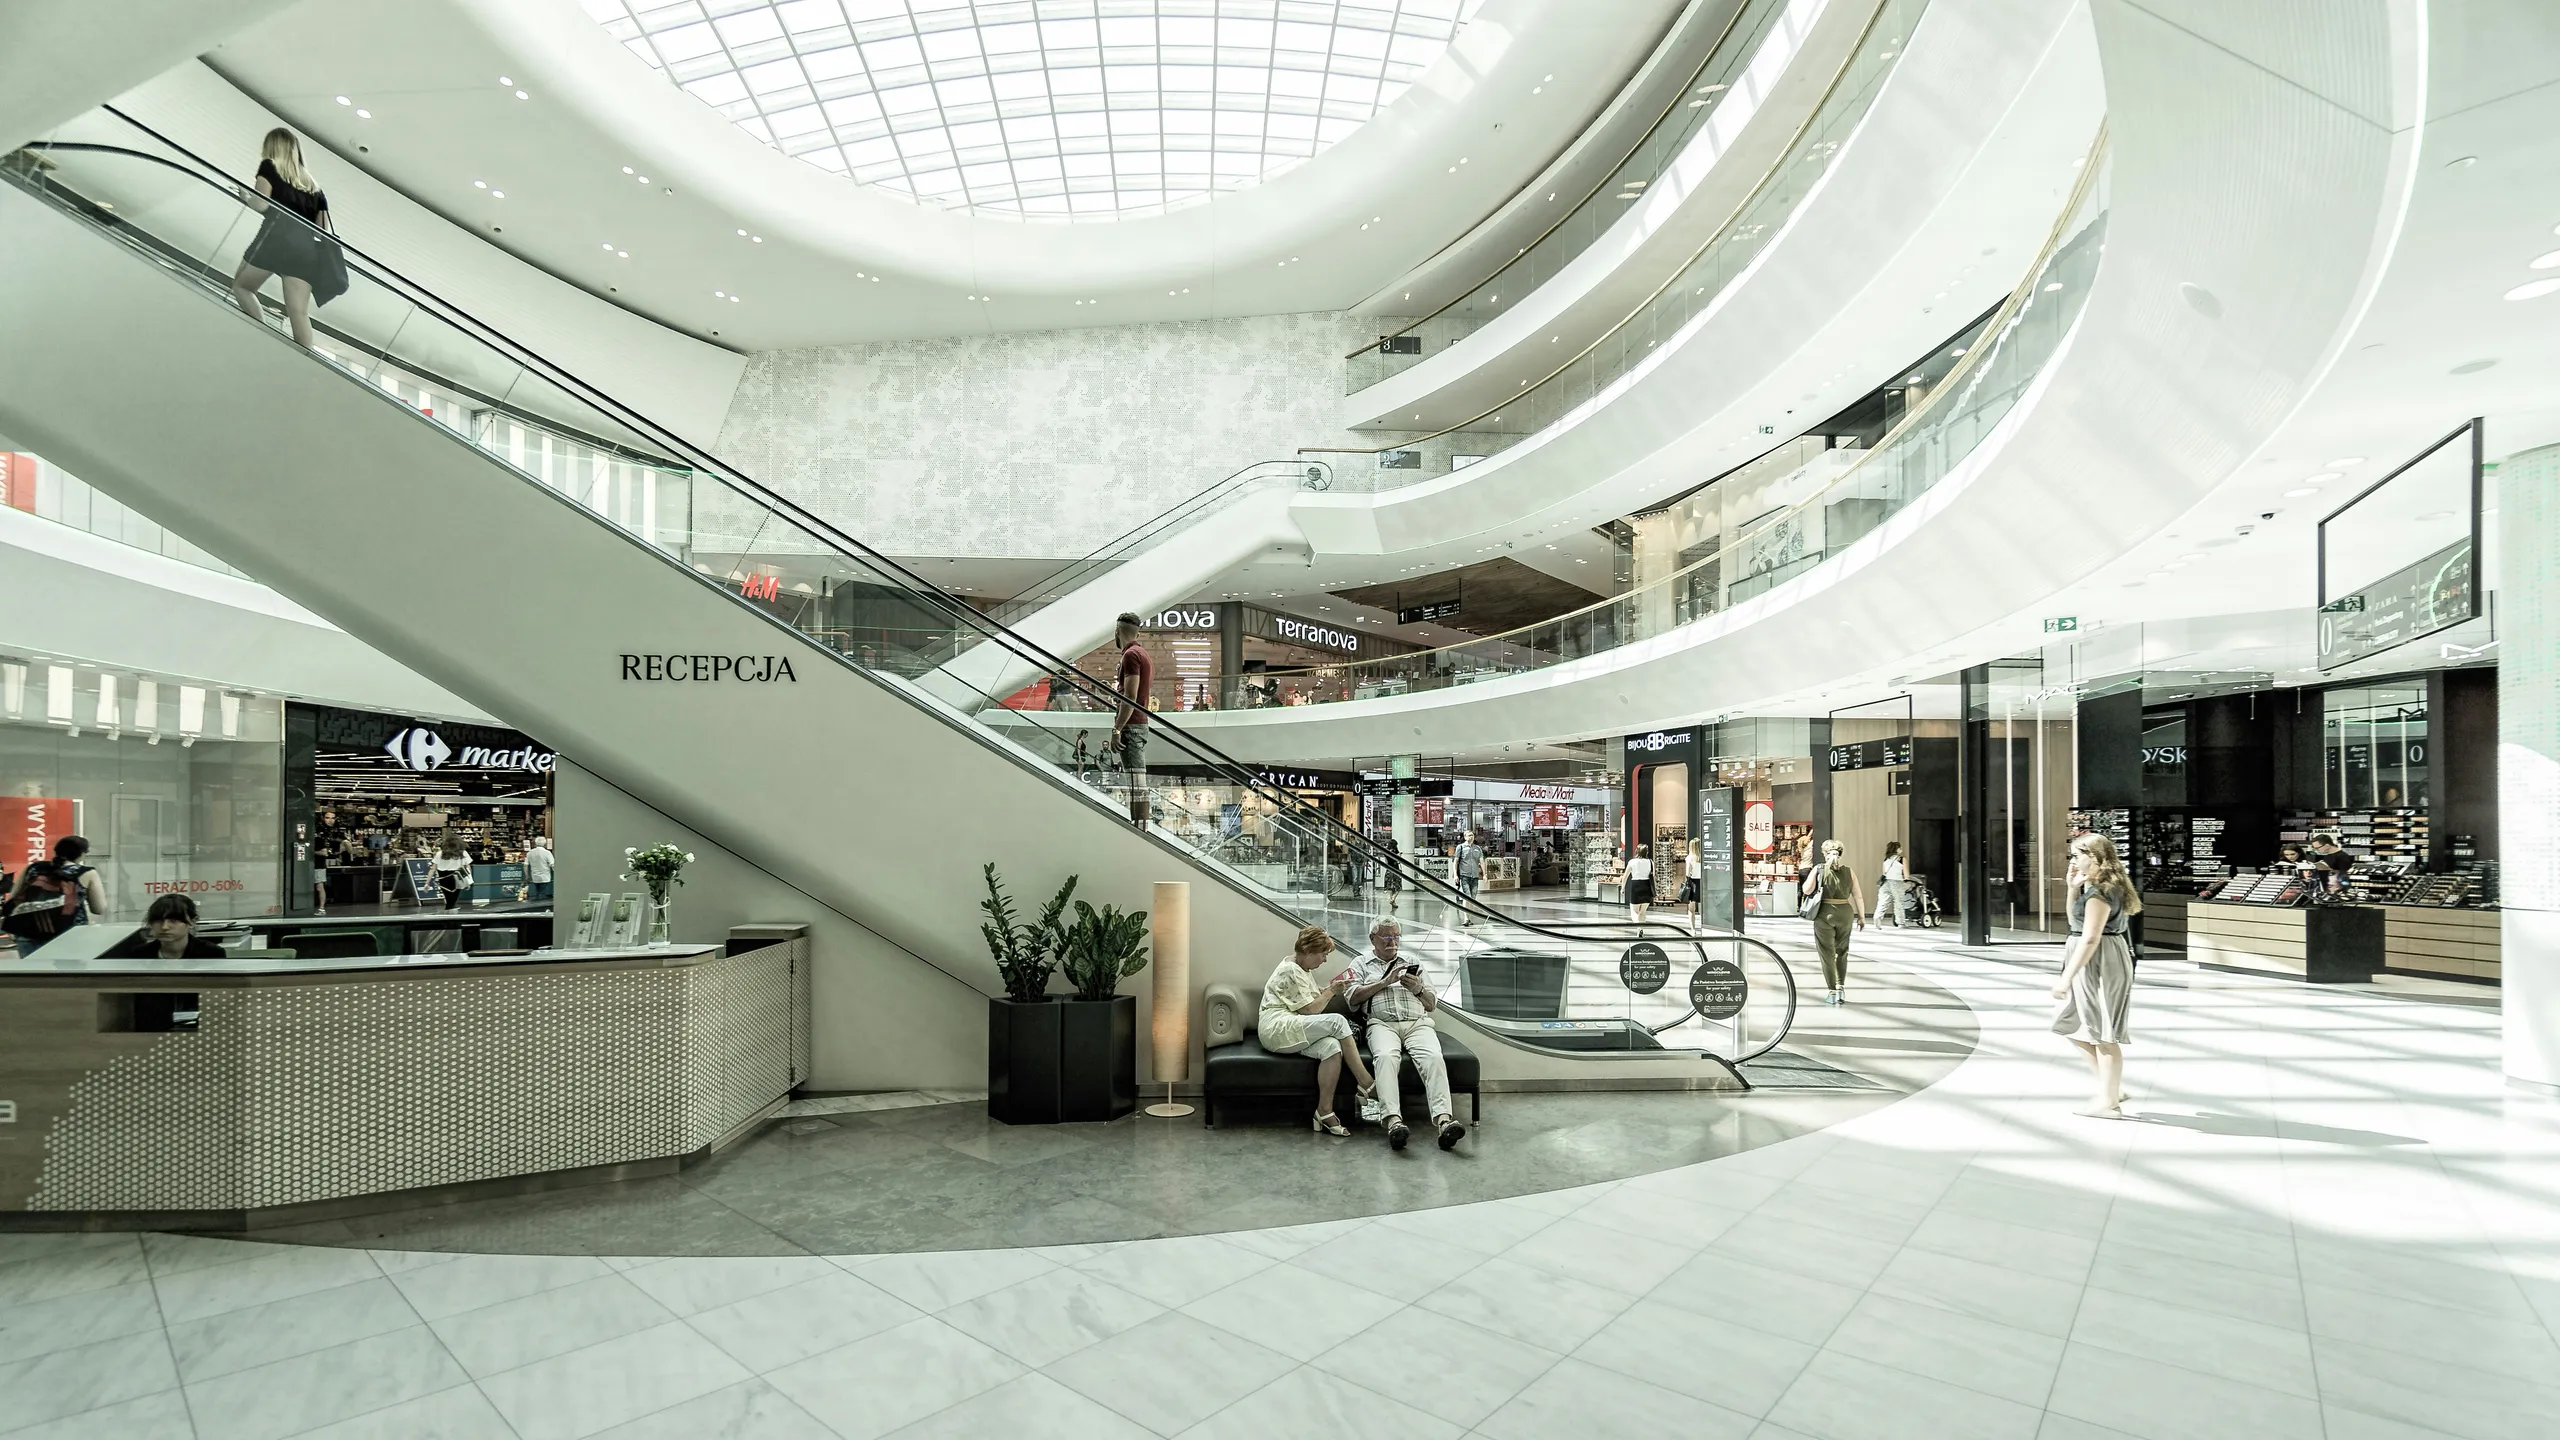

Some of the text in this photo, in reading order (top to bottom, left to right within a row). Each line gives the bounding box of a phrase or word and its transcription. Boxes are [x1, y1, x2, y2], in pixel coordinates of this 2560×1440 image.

[740, 571, 779, 603] H&M
[1140, 610, 1215, 628] nova
[2320, 617, 2333, 656] 0
[619, 654, 797, 682] RECEPCJA
[1748, 822, 1770, 832] SALE
[144, 880, 244, 894] TERAZ DO -50%
